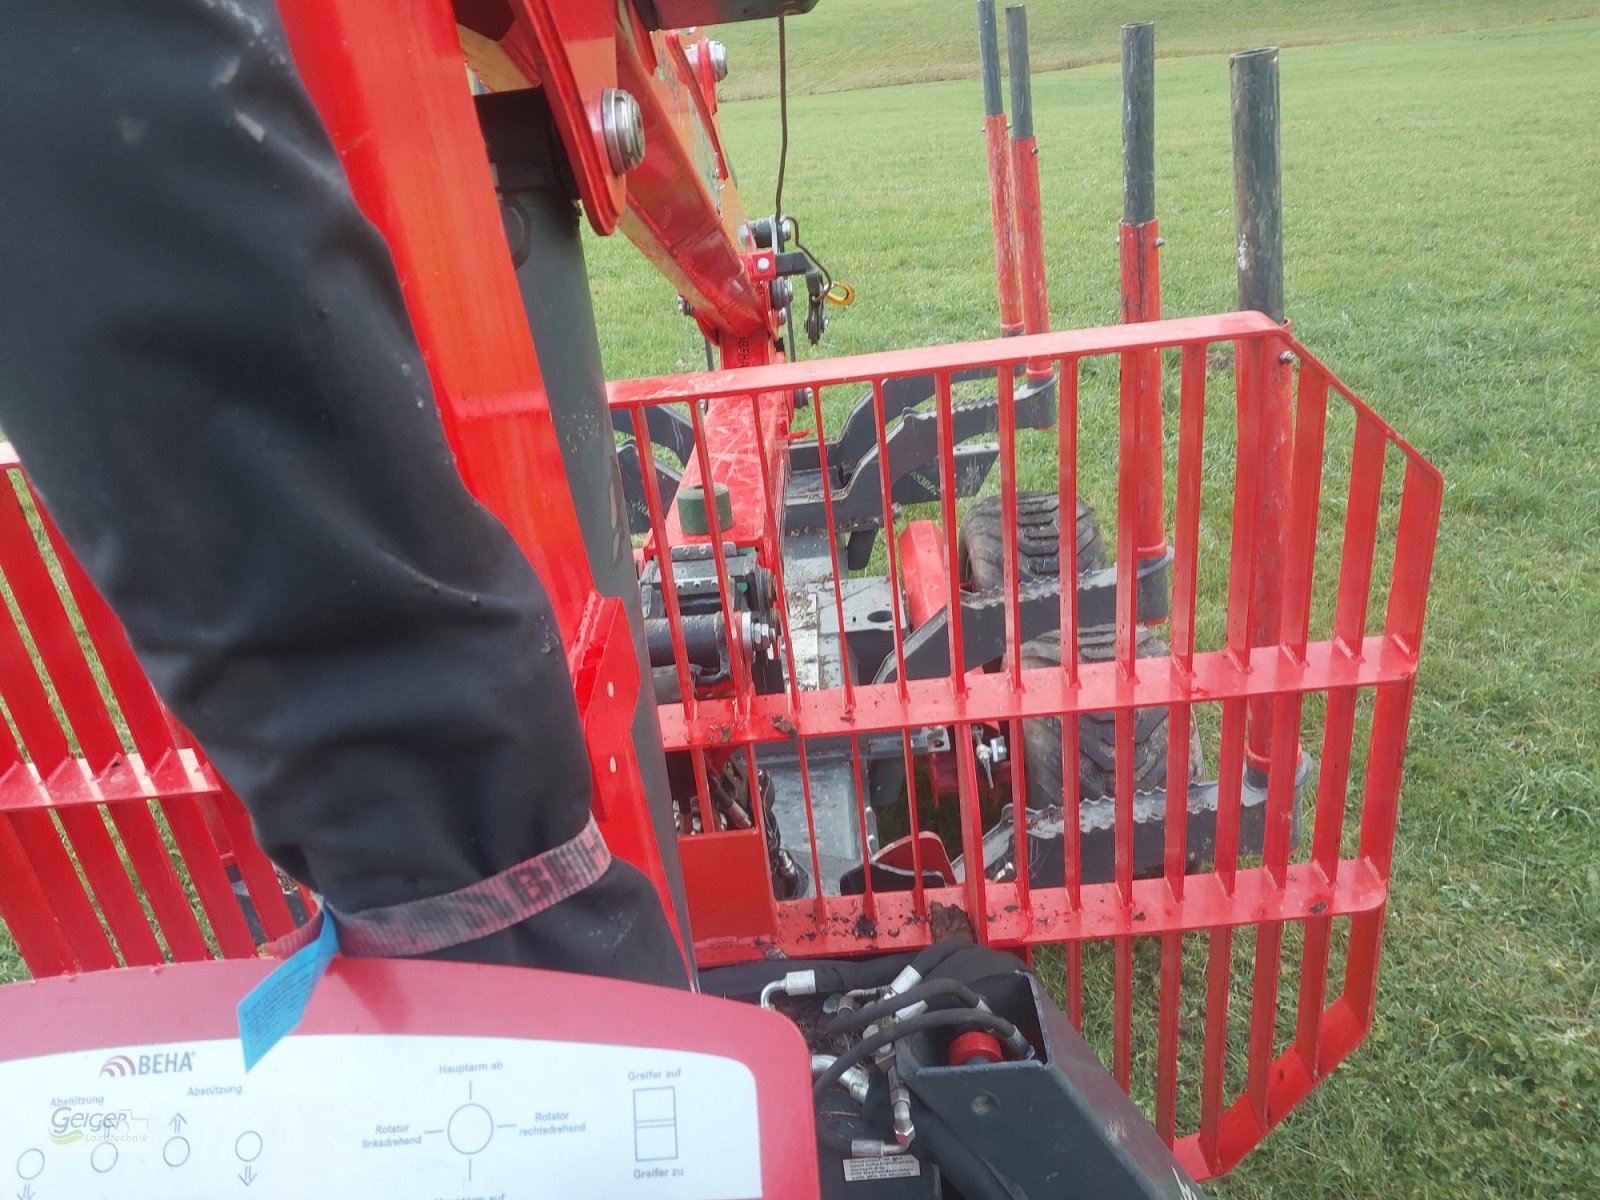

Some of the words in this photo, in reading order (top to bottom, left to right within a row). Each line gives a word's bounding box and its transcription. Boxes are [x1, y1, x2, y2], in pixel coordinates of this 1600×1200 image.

[439, 1063, 488, 1075] Hauptarm
[491, 1061, 503, 1070] ab
[628, 1069, 662, 1081] Greifer
[665, 1068, 681, 1078] auf
[187, 1085, 243, 1097] Abstützung
[50, 1096, 104, 1108] Abstützung
[535, 1112, 569, 1122] Rotator
[375, 1124, 410, 1134] Rotator
[519, 1123, 586, 1137] rechtsdrehend
[362, 1136, 422, 1149] linksdrehend
[633, 1168, 669, 1179] Greifer
[672, 1168, 684, 1176] zu
